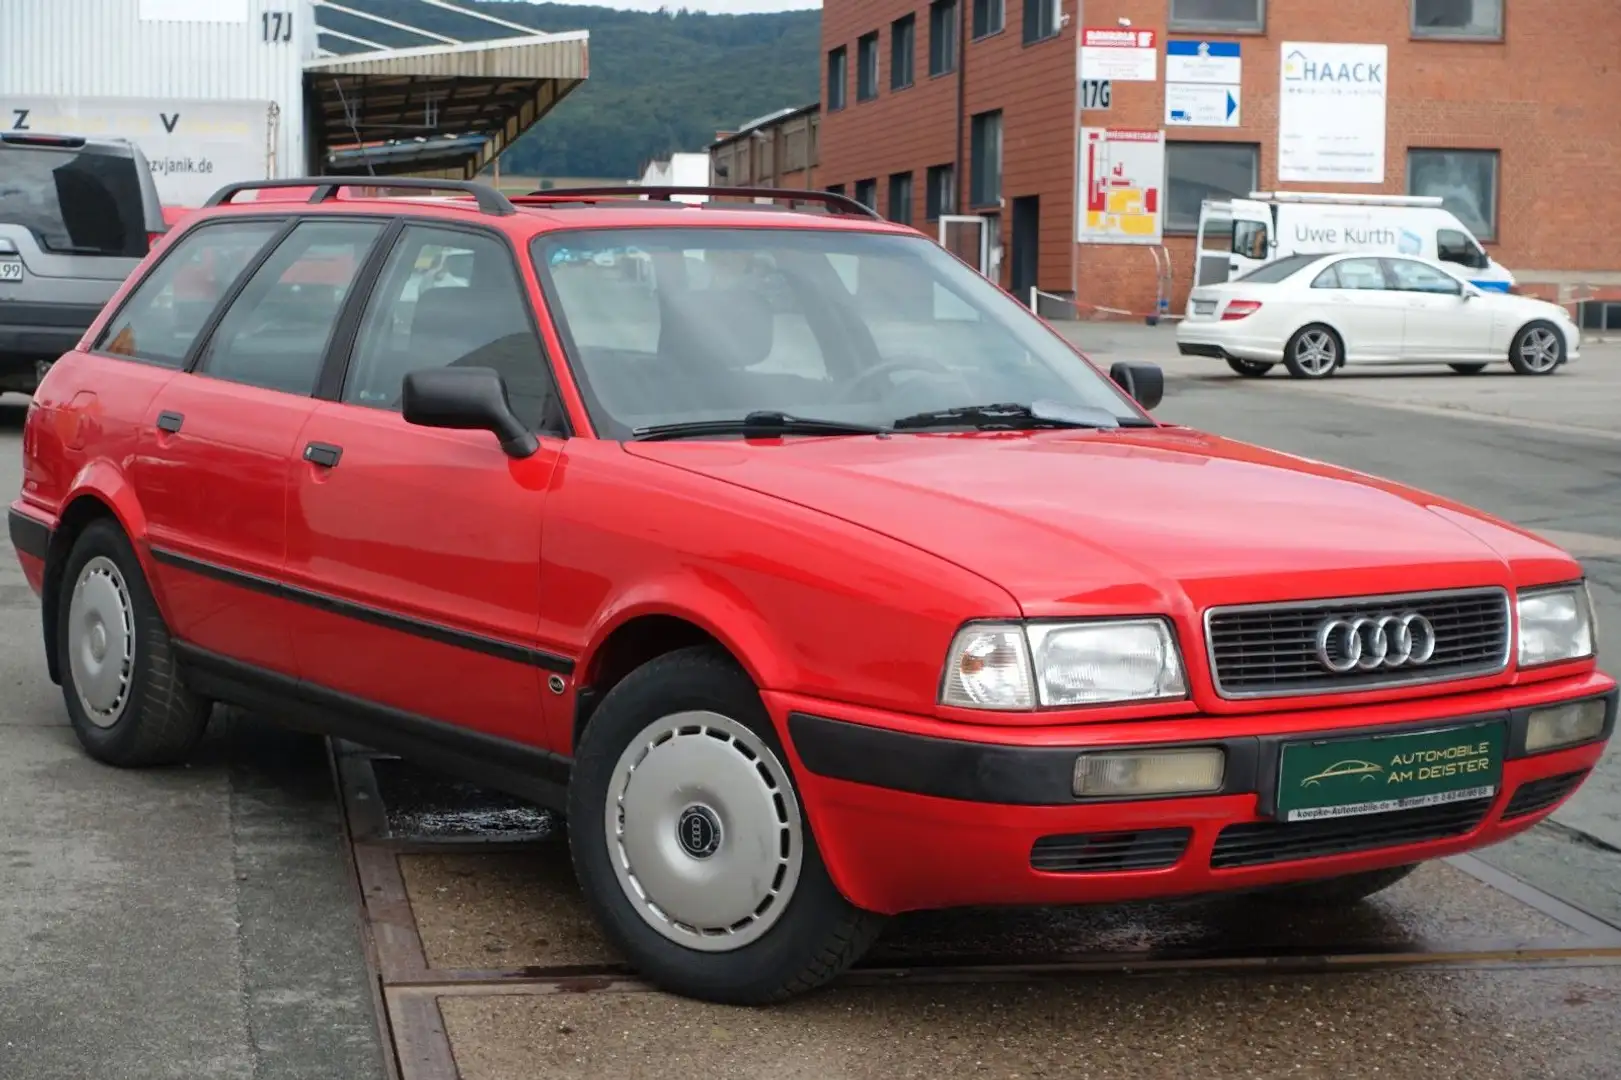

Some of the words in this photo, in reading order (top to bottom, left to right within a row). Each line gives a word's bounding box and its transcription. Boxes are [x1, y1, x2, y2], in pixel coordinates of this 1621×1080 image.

[262, 11, 292, 42] 17J
[1304, 61, 1382, 83] HAACK
[1082, 80, 1109, 107] 17G
[1295, 224, 1337, 243] Uwe
[1345, 228, 1395, 245] Kurth
[0, 263, 20, 277] 99
[1391, 741, 1490, 766] AUTOMOBILE
[1387, 771, 1413, 784] AM
[1418, 758, 1489, 780] DEISTER
